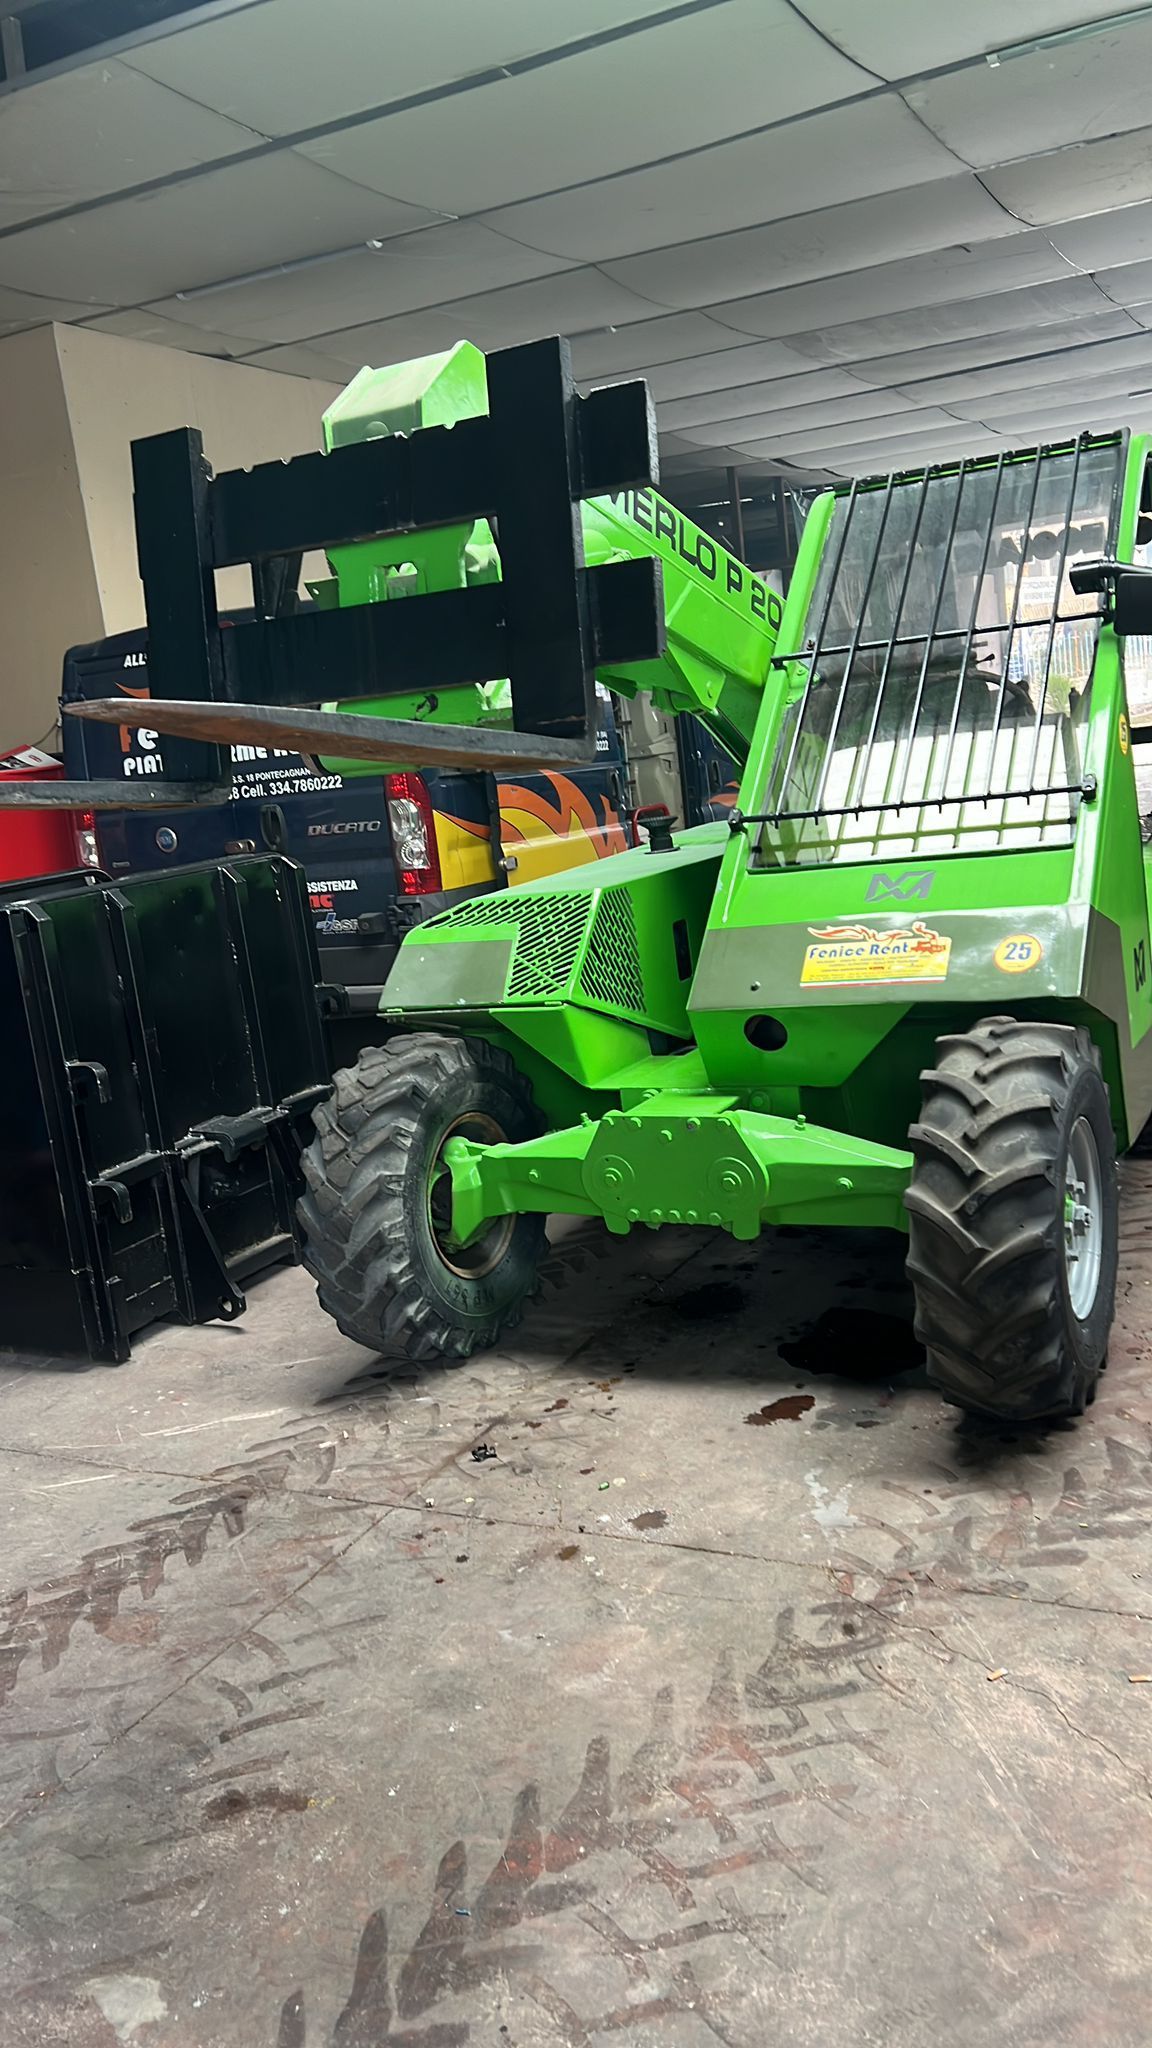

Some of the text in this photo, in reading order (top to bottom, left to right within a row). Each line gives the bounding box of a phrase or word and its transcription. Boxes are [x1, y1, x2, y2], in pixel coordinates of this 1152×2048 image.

[726, 557, 743, 594] P
[750, 578, 782, 632] 20
[240, 783, 268, 799] Cell.
[269, 775, 343, 796] 334.7860222
[307, 820, 382, 836] DUCATO
[809, 942, 909, 960] Fenice Rent
[1003, 941, 1033, 961] 25
